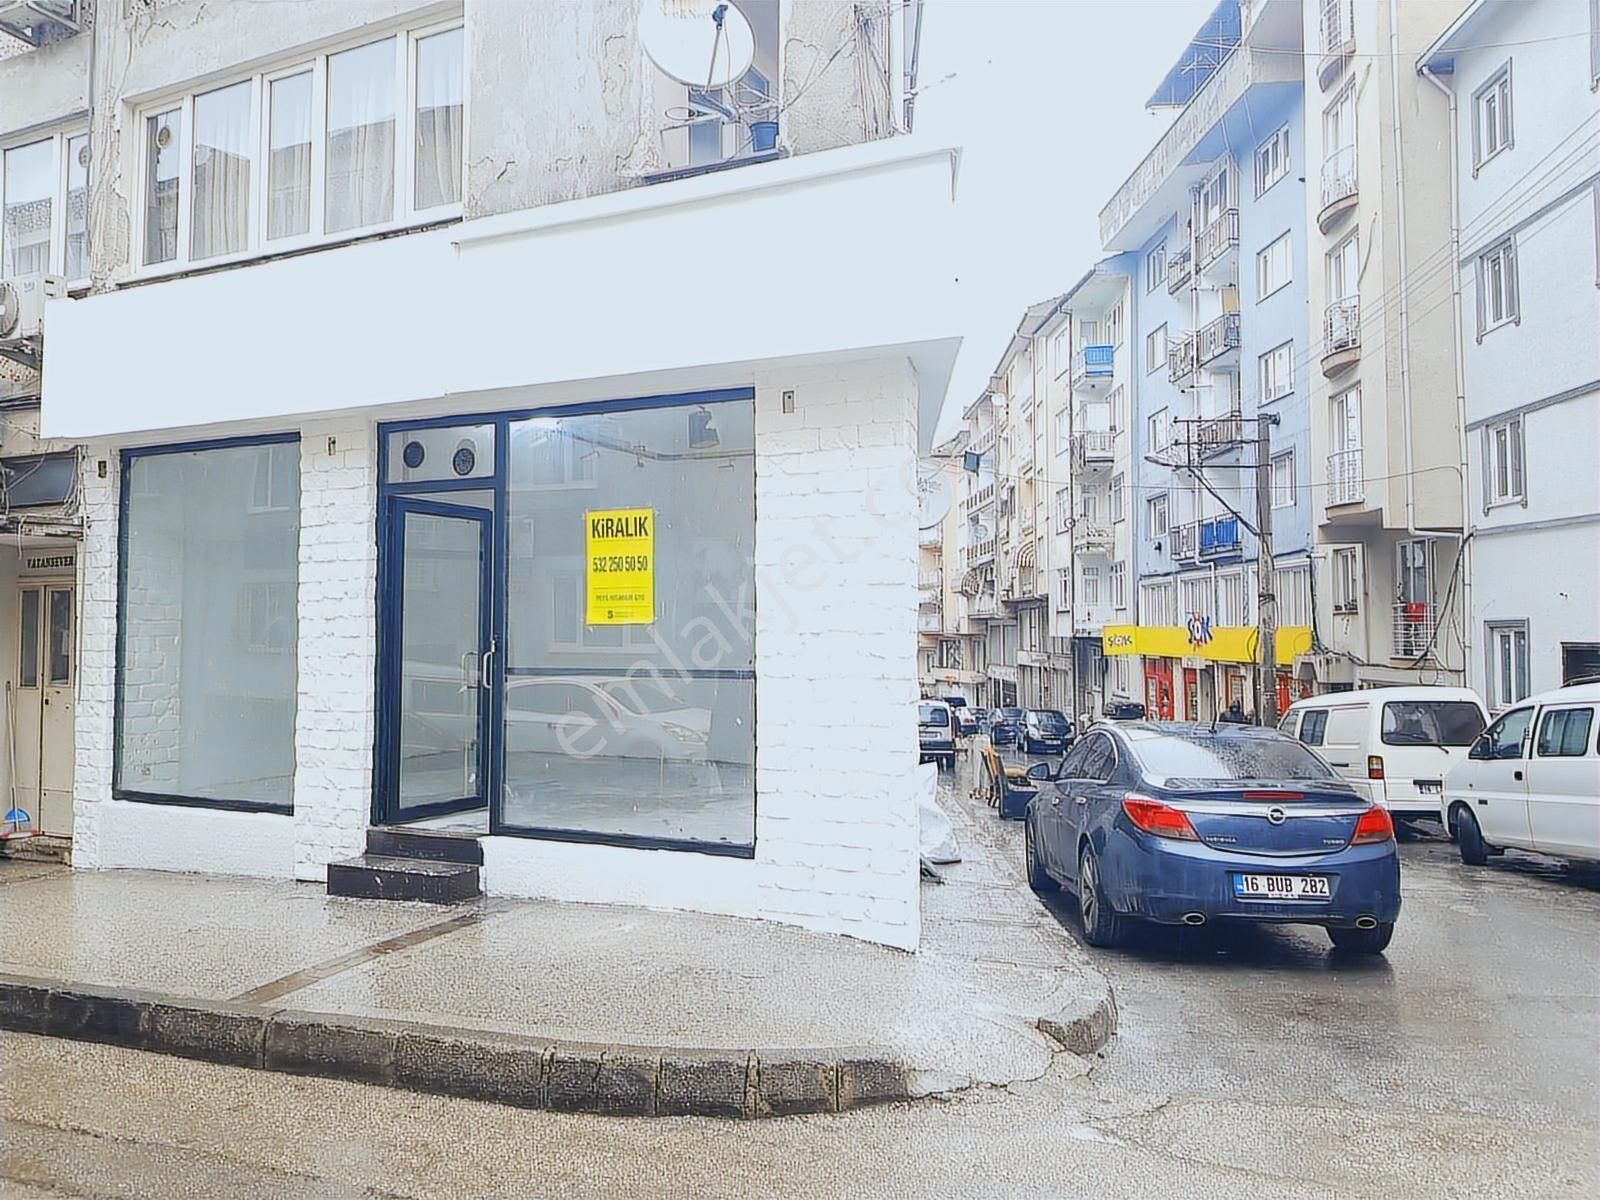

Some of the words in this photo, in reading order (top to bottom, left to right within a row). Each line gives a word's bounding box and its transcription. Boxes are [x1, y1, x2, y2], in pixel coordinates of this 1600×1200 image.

[593, 557, 607, 572] 532
[609, 556, 624, 572] 250
[625, 556, 636, 571] 50
[637, 555, 648, 571] 50
[1245, 876, 1260, 892] 16
[1267, 877, 1293, 893] BUB
[1301, 878, 1327, 894] 282
